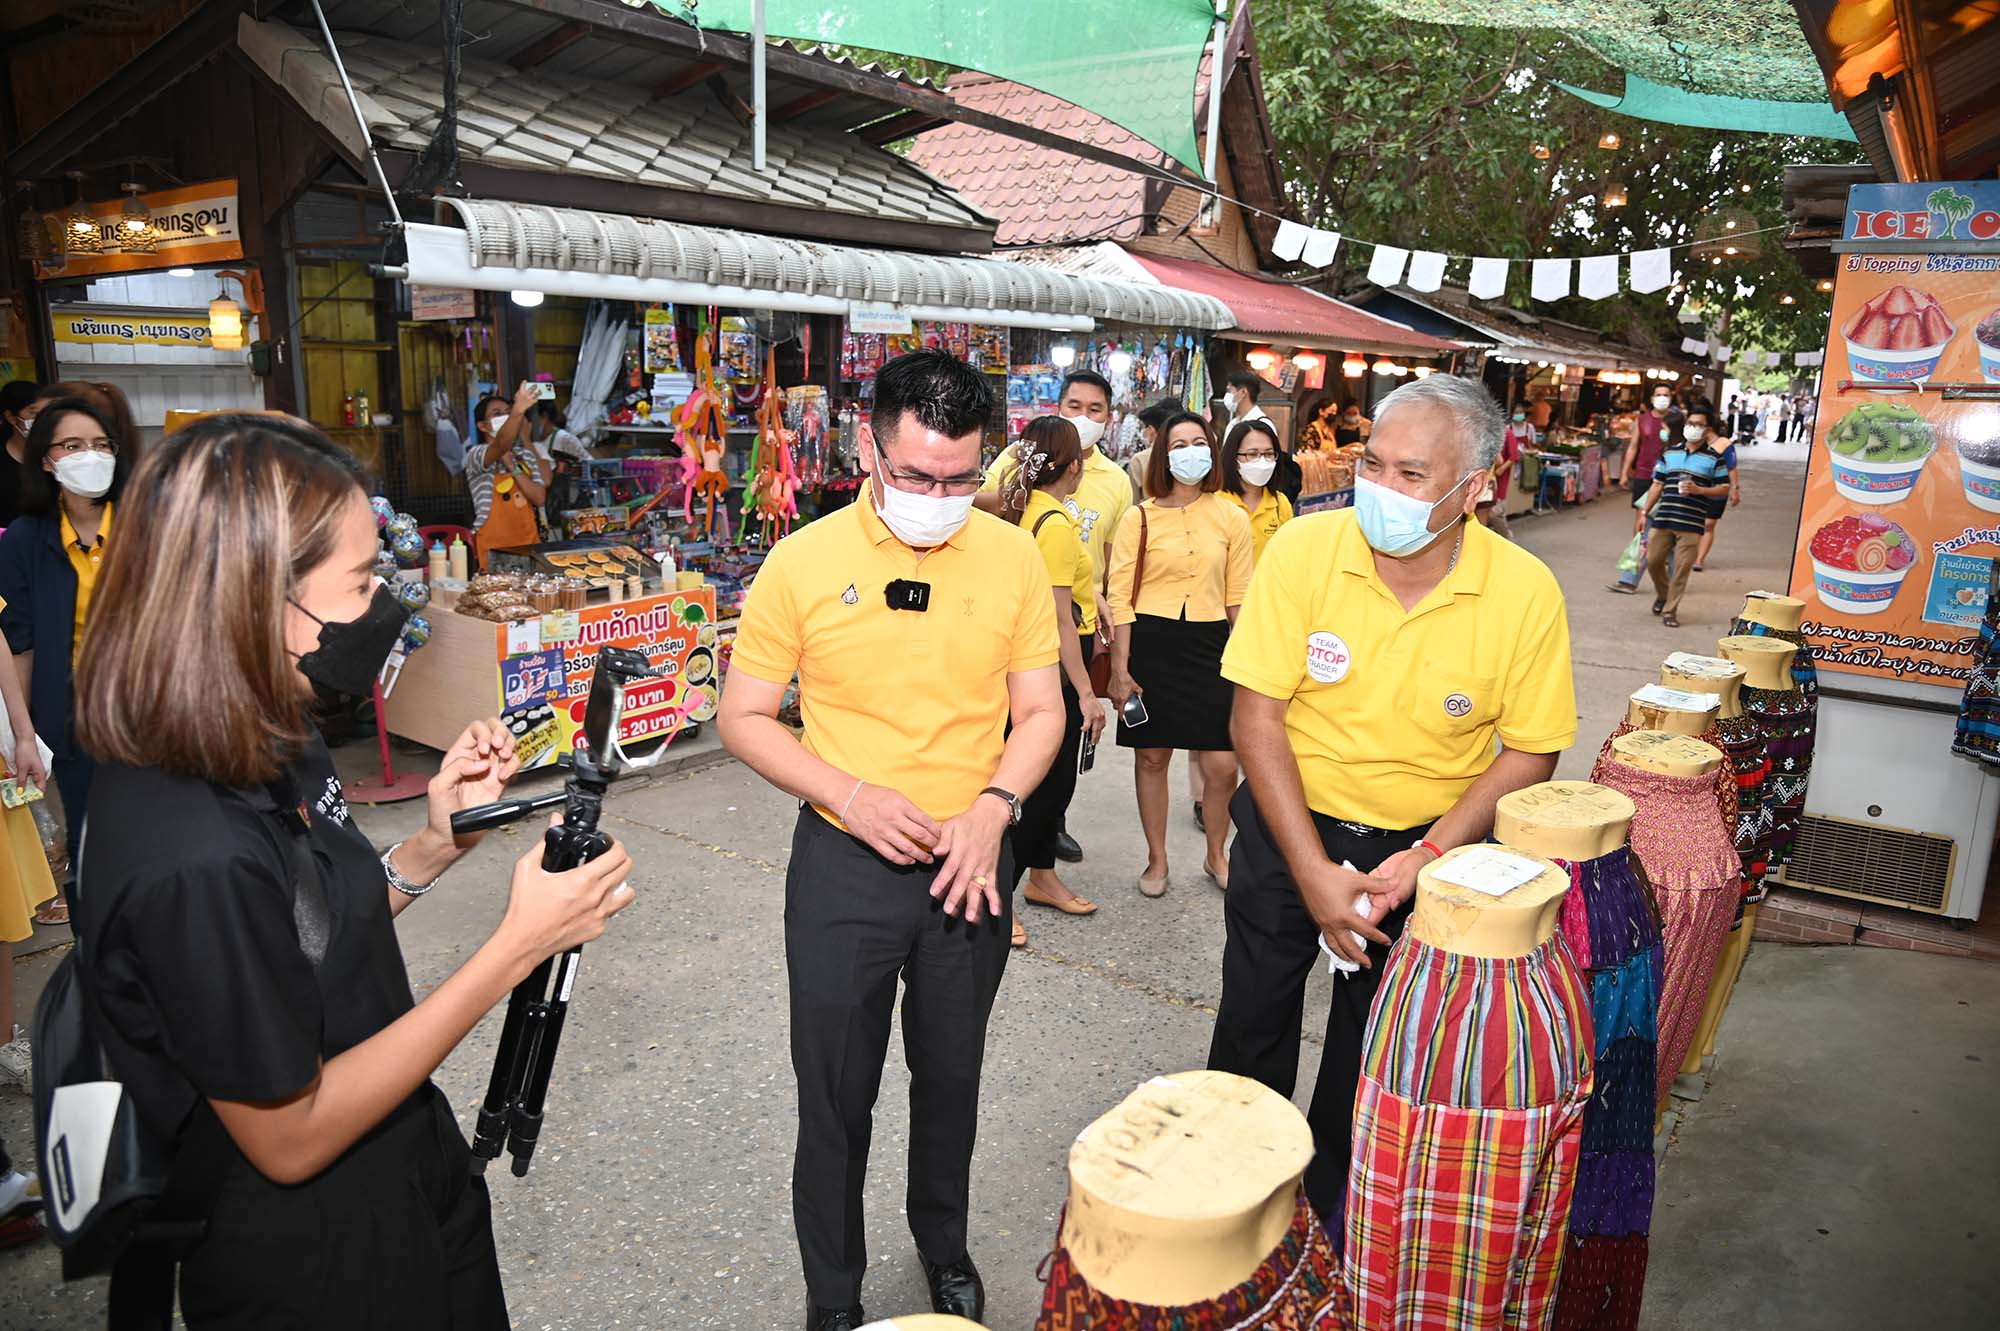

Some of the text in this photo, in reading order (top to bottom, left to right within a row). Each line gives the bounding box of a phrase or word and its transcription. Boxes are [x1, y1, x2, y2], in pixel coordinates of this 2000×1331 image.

[1851, 210, 1931, 239] ICE
[1864, 257, 1921, 273] Topping
[1940, 566, 1990, 583] โครงการ
[1315, 637, 1338, 650] TEAM
[639, 689, 665, 705] บาท
[630, 719, 648, 736] 20
[650, 713, 675, 730] บาท
